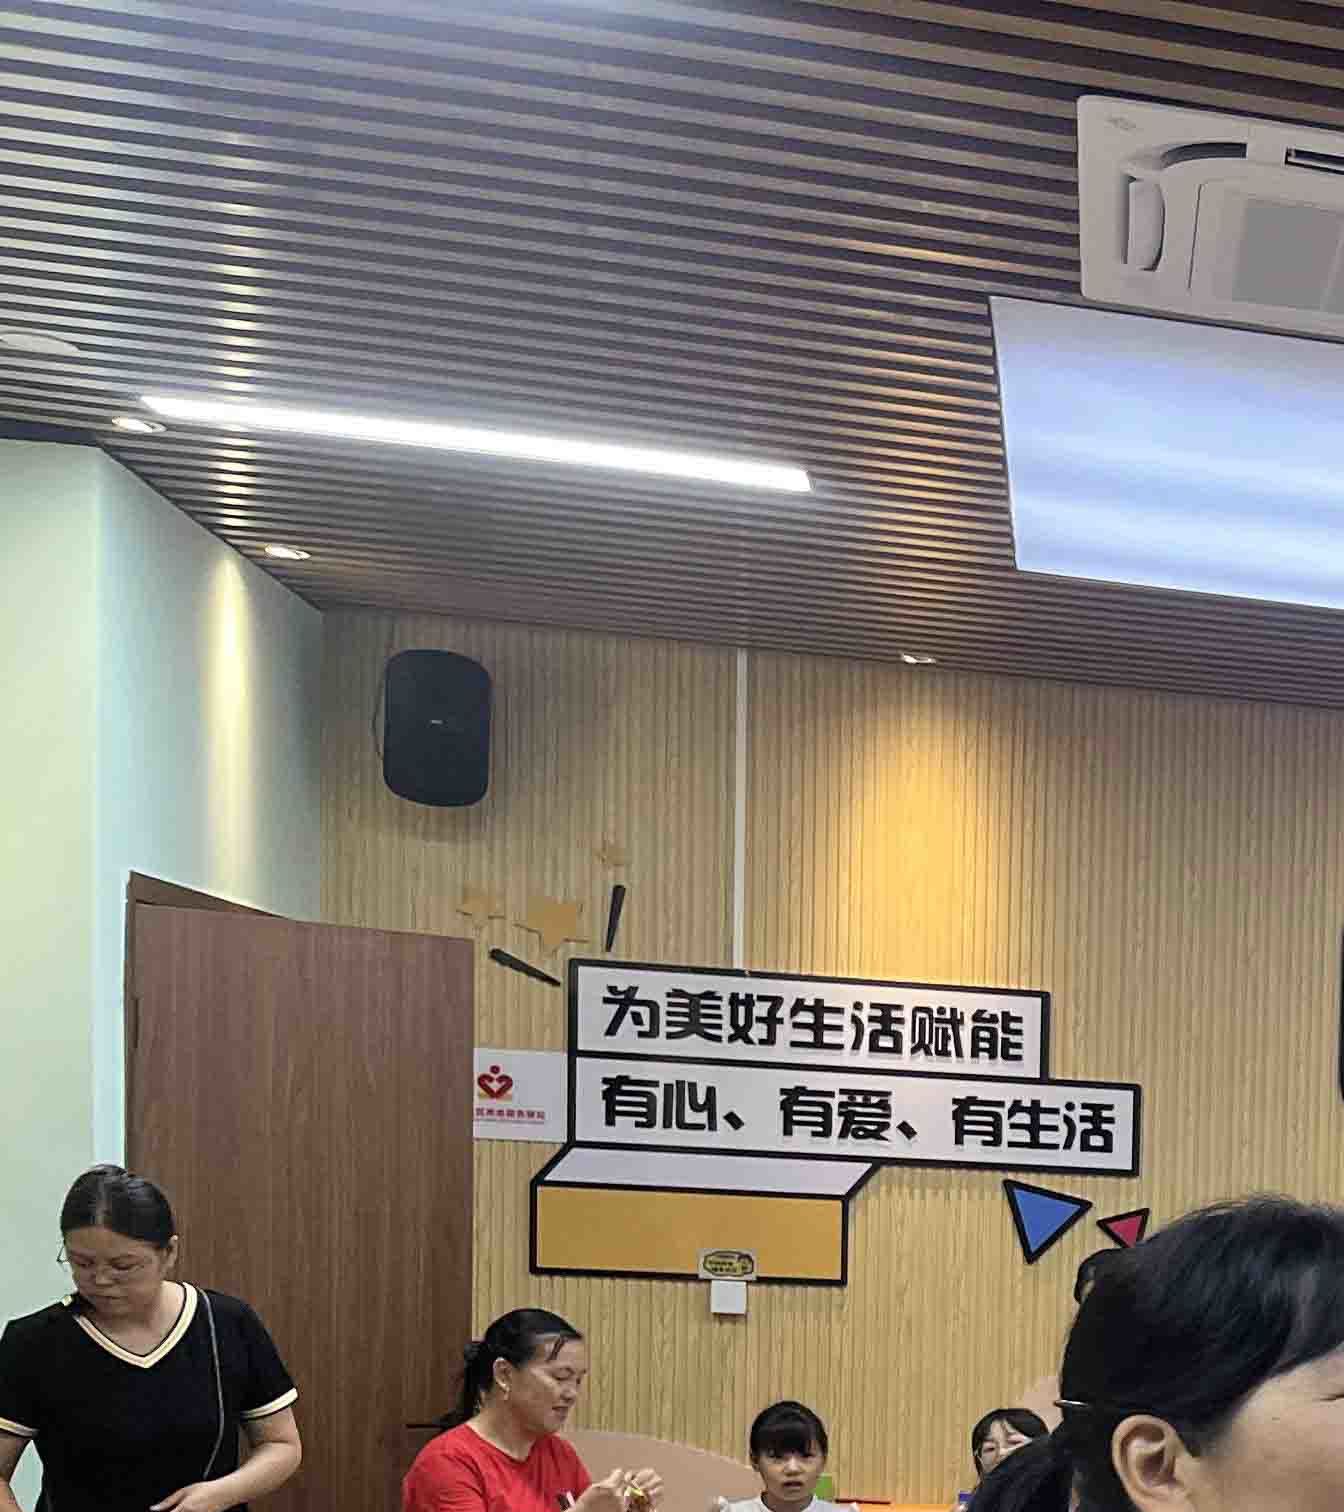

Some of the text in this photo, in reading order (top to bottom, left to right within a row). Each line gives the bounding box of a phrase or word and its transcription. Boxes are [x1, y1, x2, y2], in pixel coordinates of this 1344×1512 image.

[601, 984, 1024, 1062] 为美好生活赋能
[601, 1074, 1115, 1155] 有心、有爱、有生活
